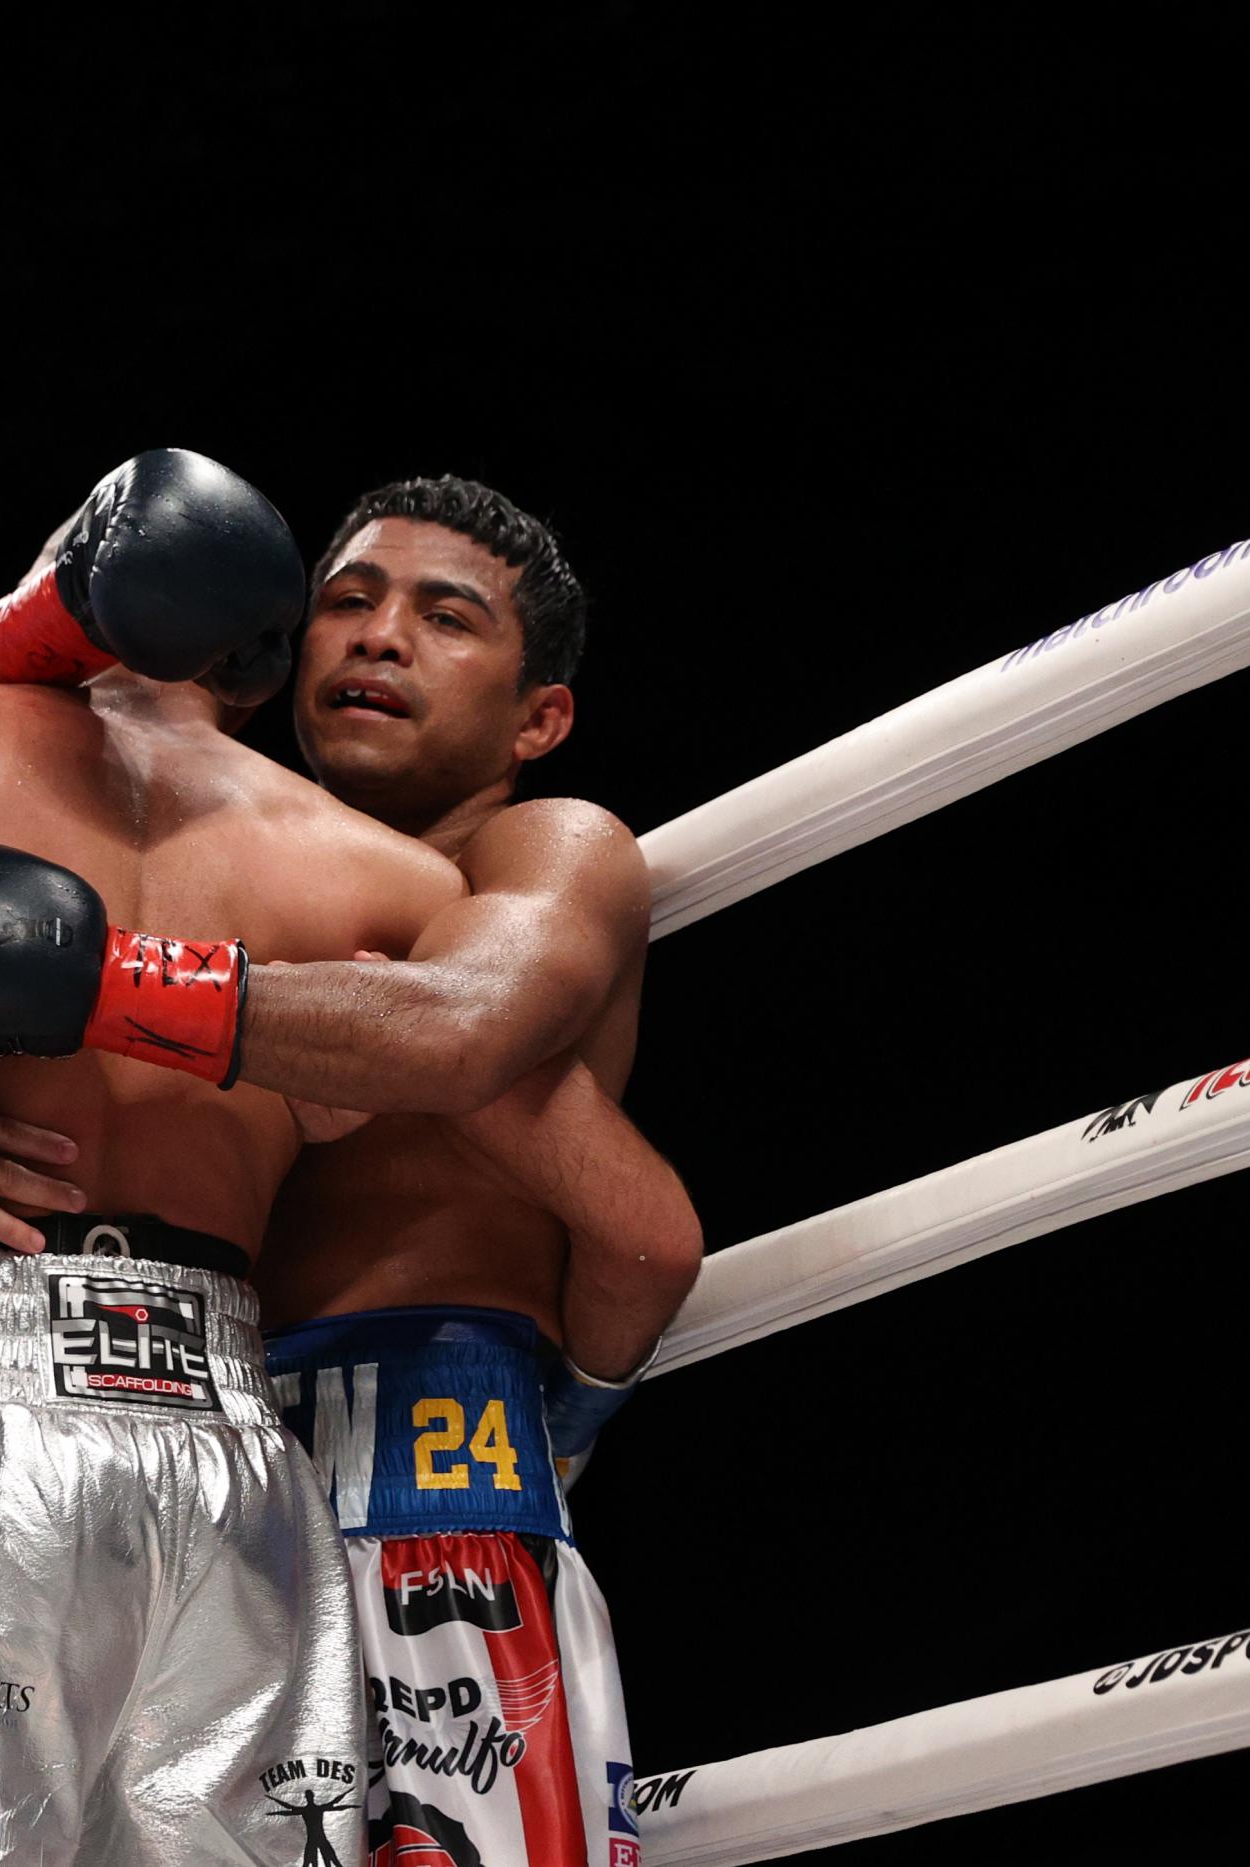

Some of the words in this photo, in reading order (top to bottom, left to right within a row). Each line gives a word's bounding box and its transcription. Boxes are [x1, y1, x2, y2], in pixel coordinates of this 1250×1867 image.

[52, 1319, 209, 1379] ELITE
[88, 1374, 192, 1396] SCAFFOLDING
[412, 1397, 522, 1491] 24
[400, 1561, 495, 1606] FSLN
[259, 1759, 307, 1793] TEAM
[316, 1758, 356, 1784] DES
